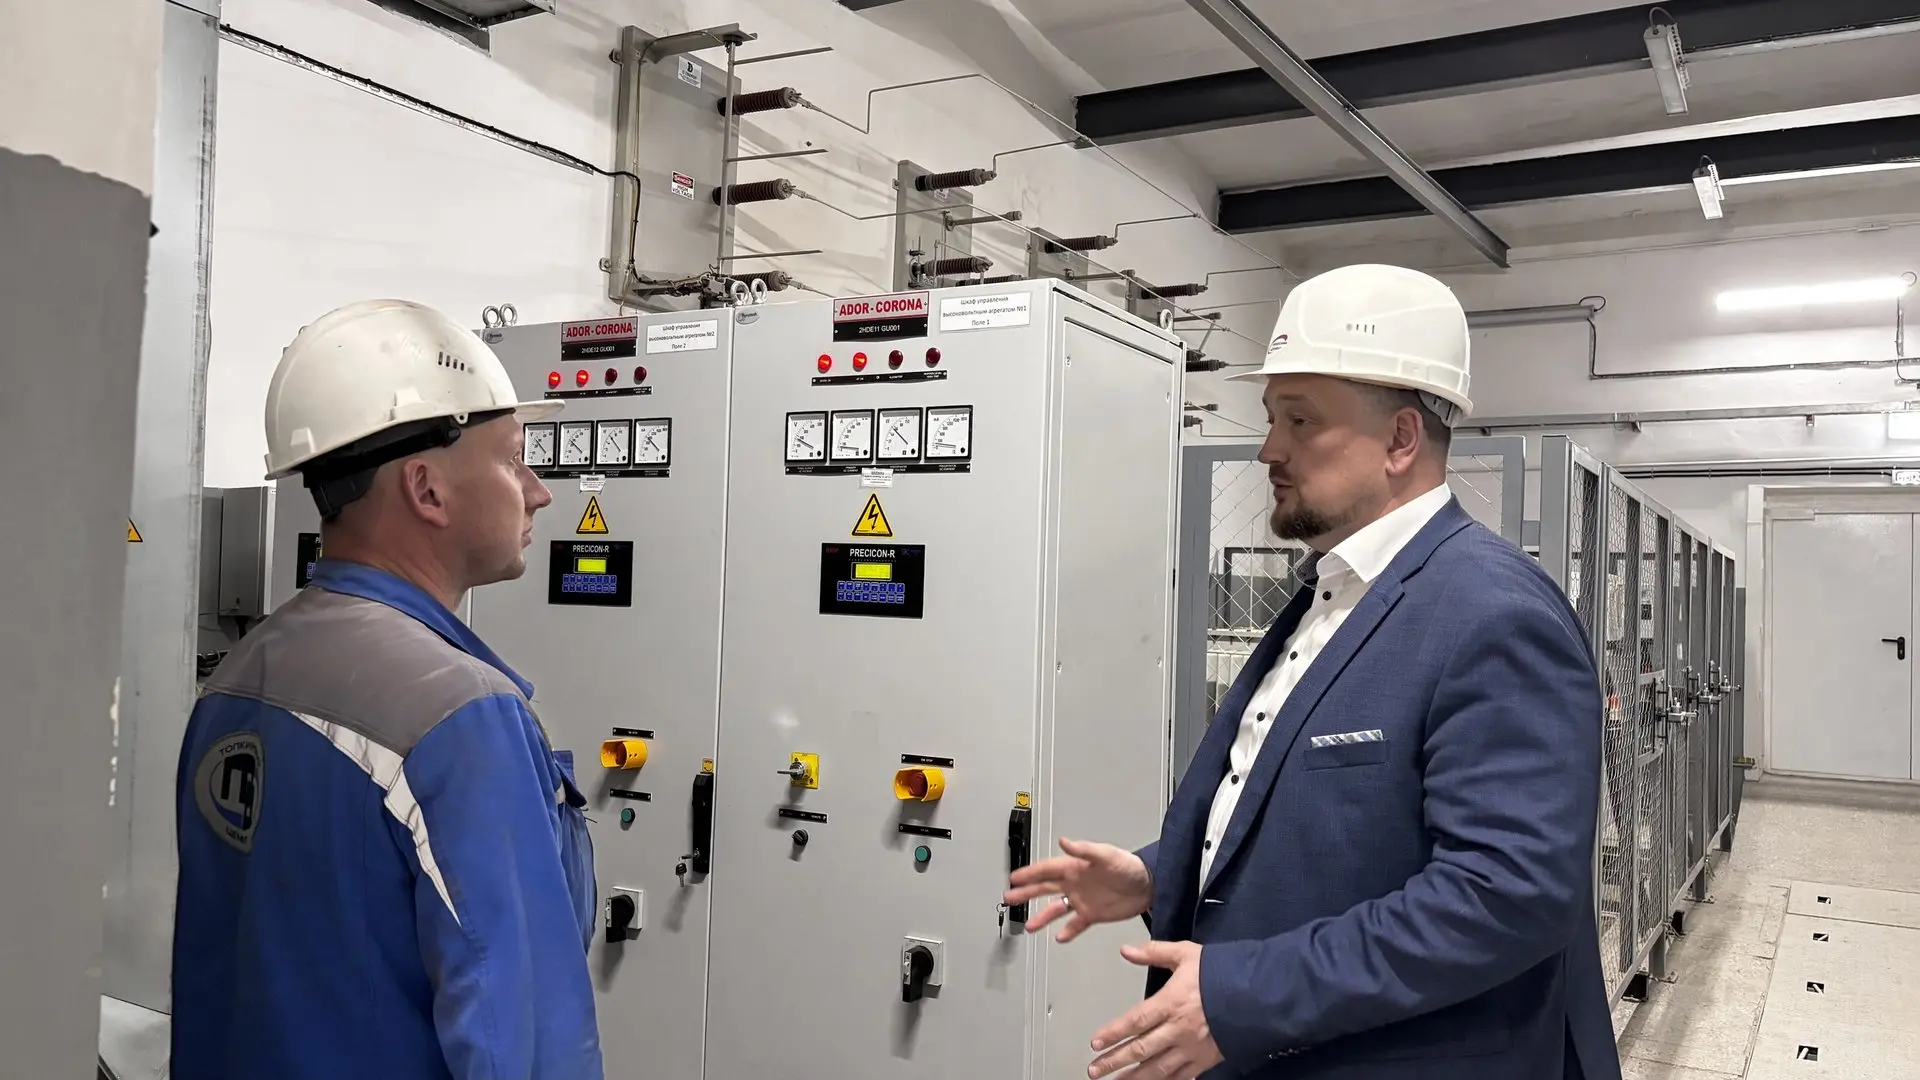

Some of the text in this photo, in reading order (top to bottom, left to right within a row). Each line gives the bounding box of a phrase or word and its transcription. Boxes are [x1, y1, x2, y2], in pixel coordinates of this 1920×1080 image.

[977, 296, 1008, 304] управления
[988, 307, 1015, 315] агрегатом
[859, 324, 900, 334] 2HDE11 GU001
[573, 545, 610, 553] PRECICON-R
[849, 548, 896, 558] PRECICON-R
